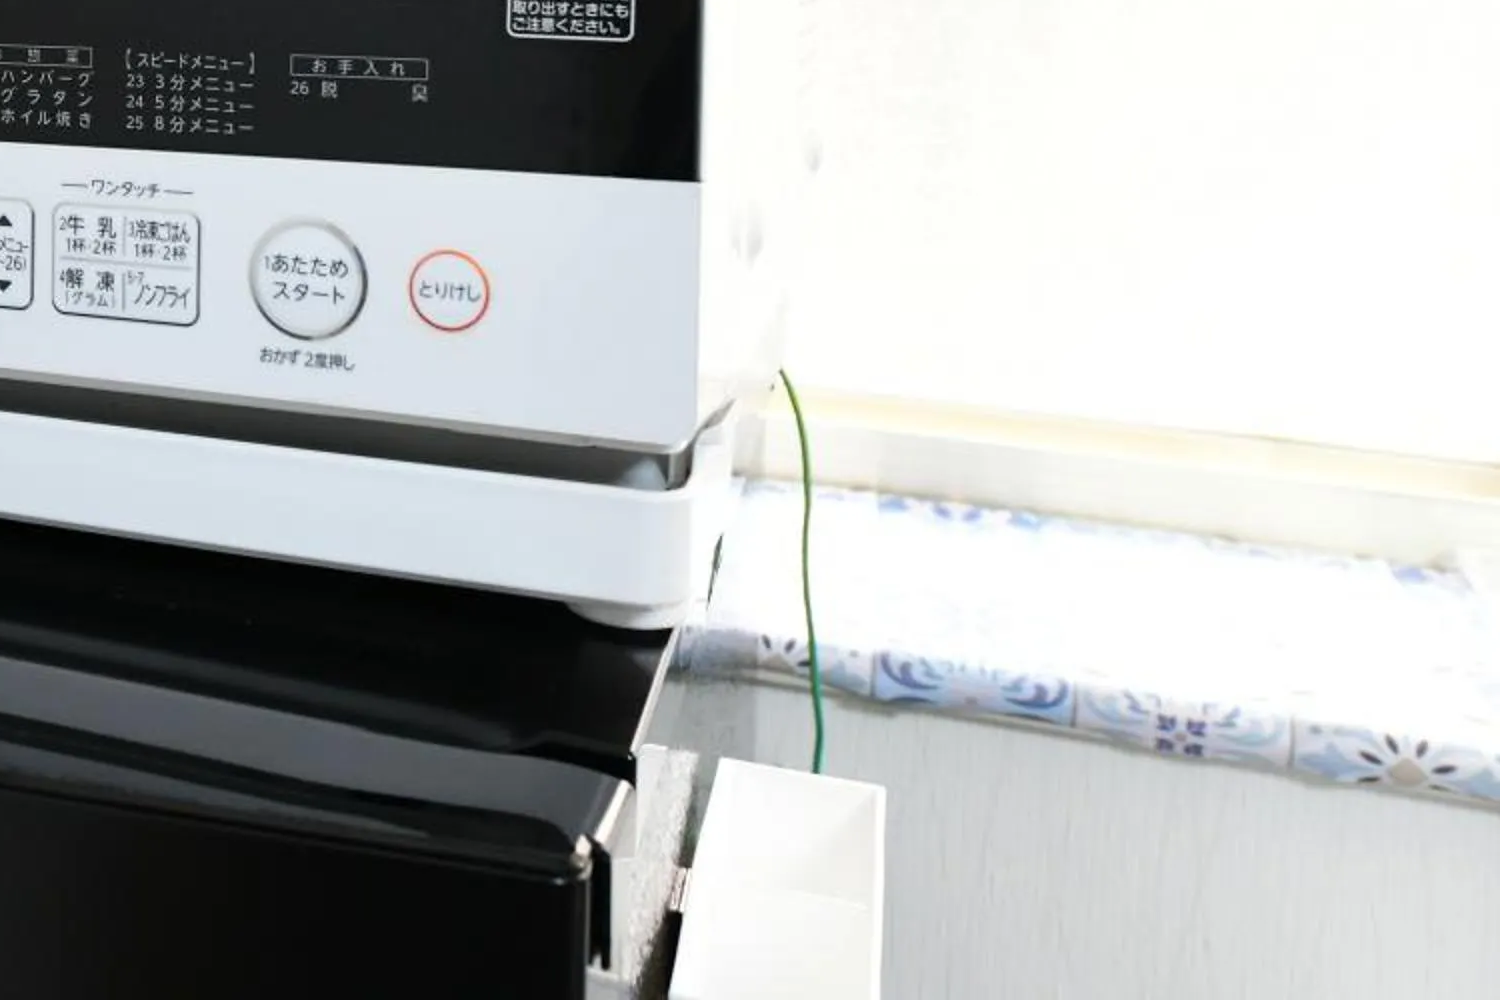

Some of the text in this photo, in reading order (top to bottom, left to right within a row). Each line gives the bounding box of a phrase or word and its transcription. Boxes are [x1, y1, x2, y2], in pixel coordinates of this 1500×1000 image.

[311, 58, 405, 76] お手入れ
[1, 69, 95, 87] ハンバーグ
[126, 73, 145, 88] 23
[290, 80, 309, 95] 26
[125, 94, 143, 109] 24
[125, 115, 144, 130] 25
[91, 179, 161, 199] ワンタッチ
[134, 284, 190, 309] ノンフライ
[273, 281, 345, 304] スタート
[419, 280, 481, 302] とりけし
